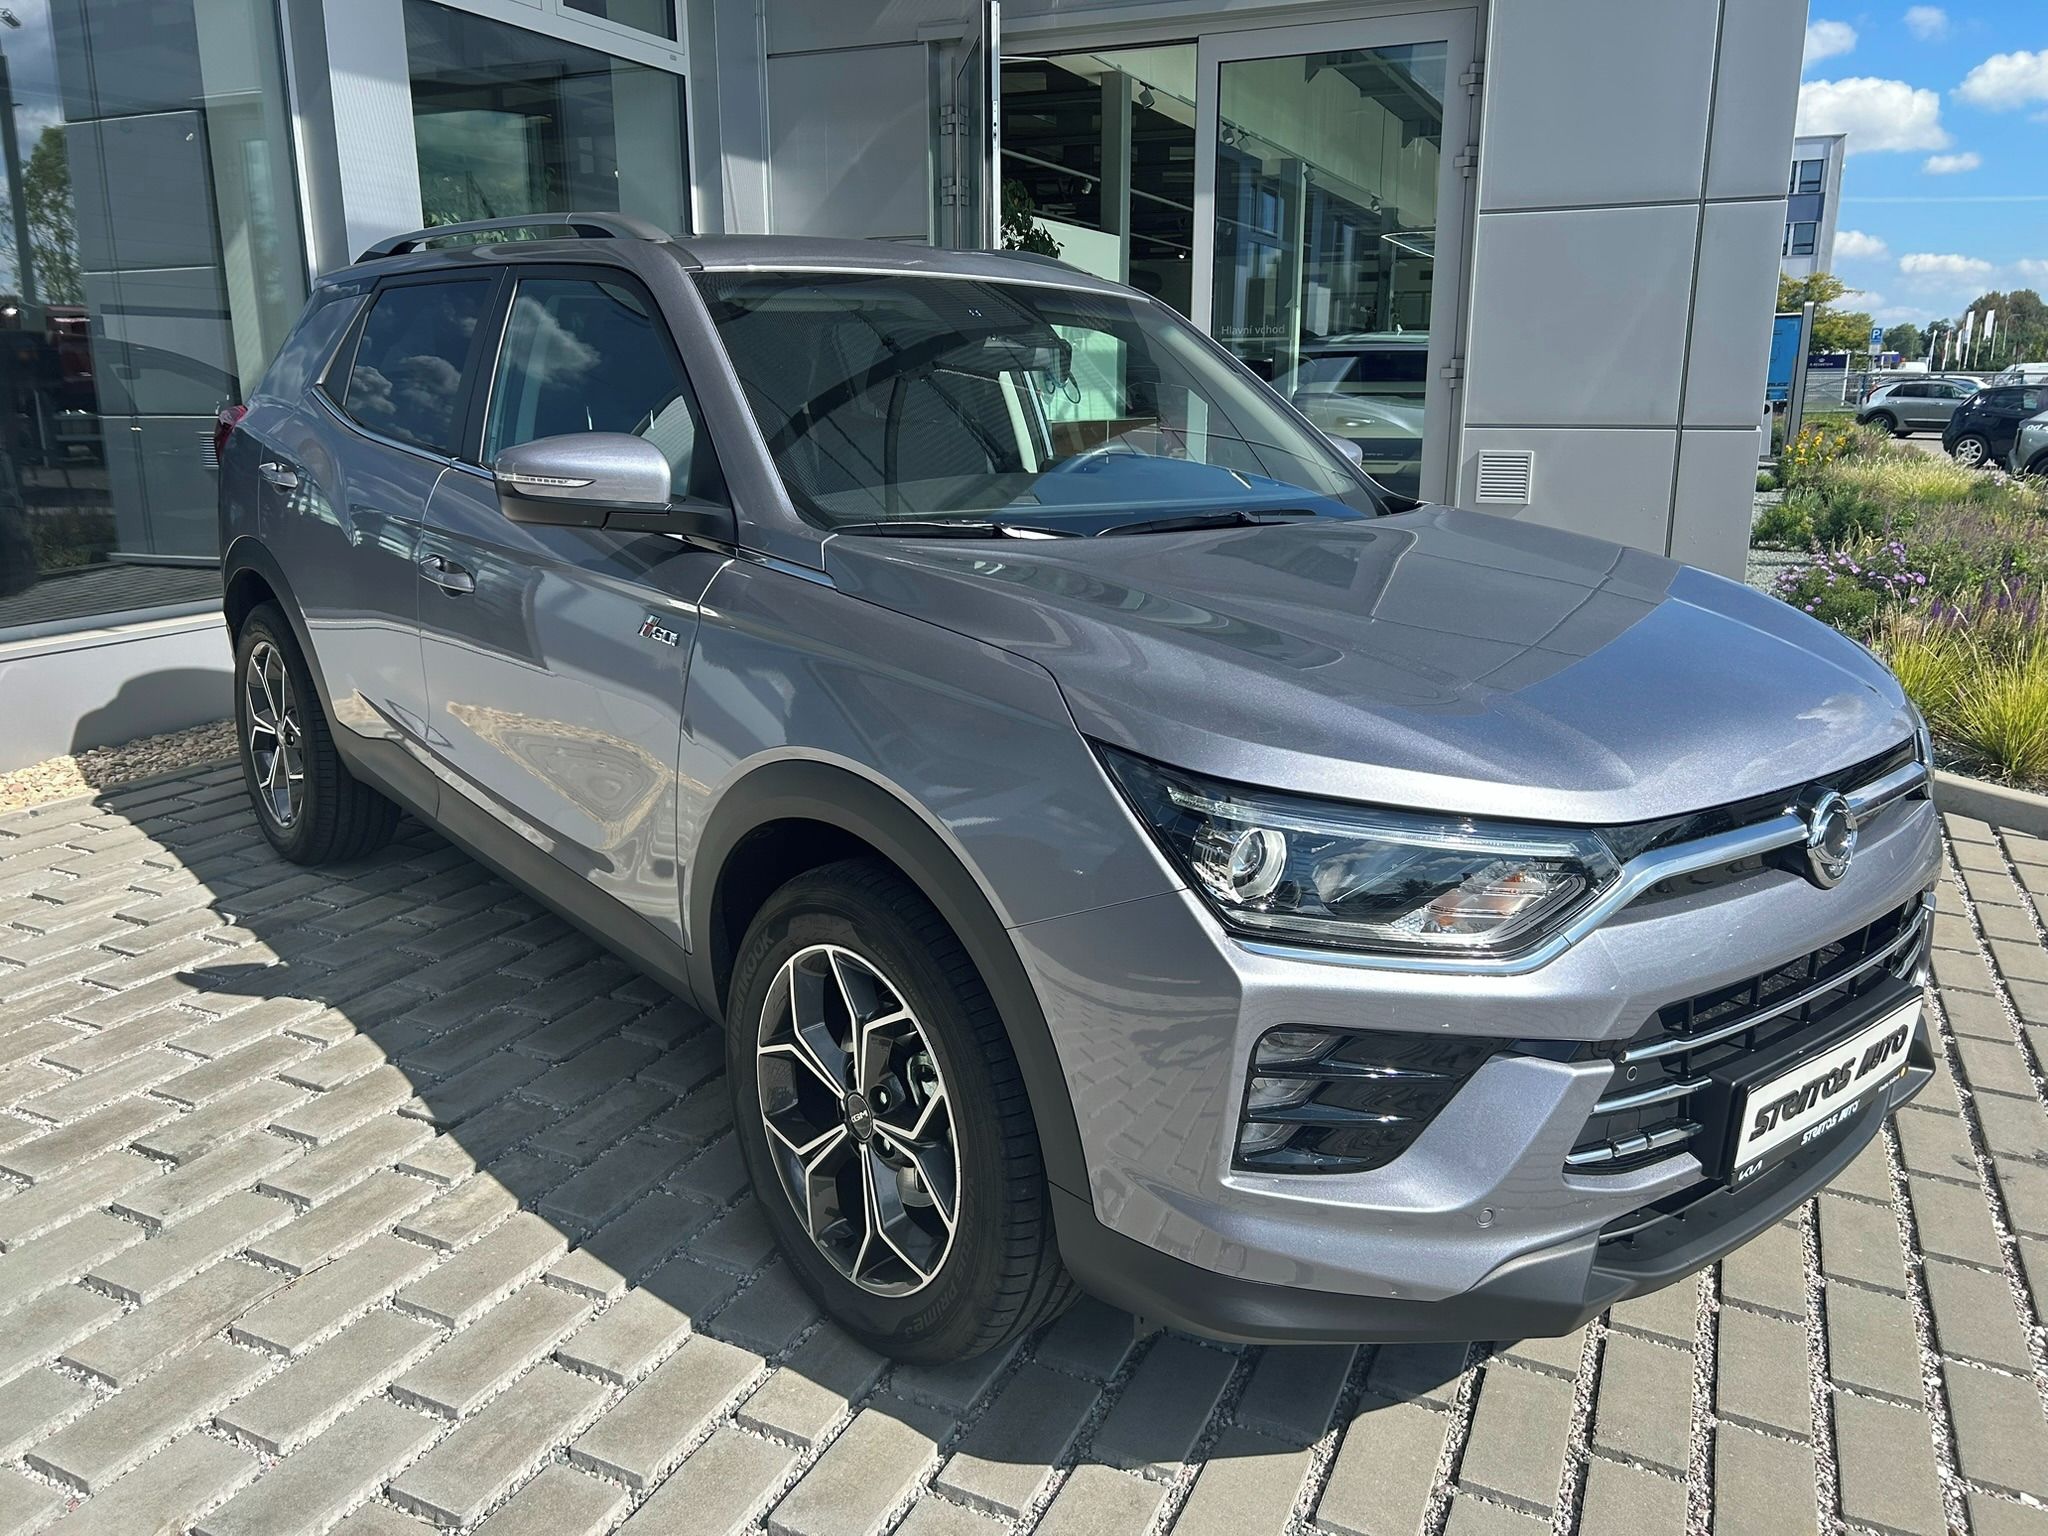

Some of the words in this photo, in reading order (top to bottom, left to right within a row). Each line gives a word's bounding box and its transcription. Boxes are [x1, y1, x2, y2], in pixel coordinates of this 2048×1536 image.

[1221, 325, 1252, 335] Hlavní
[1255, 324, 1285, 334] vchod
[1872, 329, 1881, 339] P
[1748, 1057, 1857, 1143] STRATOS
[1853, 1024, 1909, 1081] AUTO
[1800, 1112, 1839, 1146] STRATOS
[1837, 1100, 1860, 1123] AUTO
